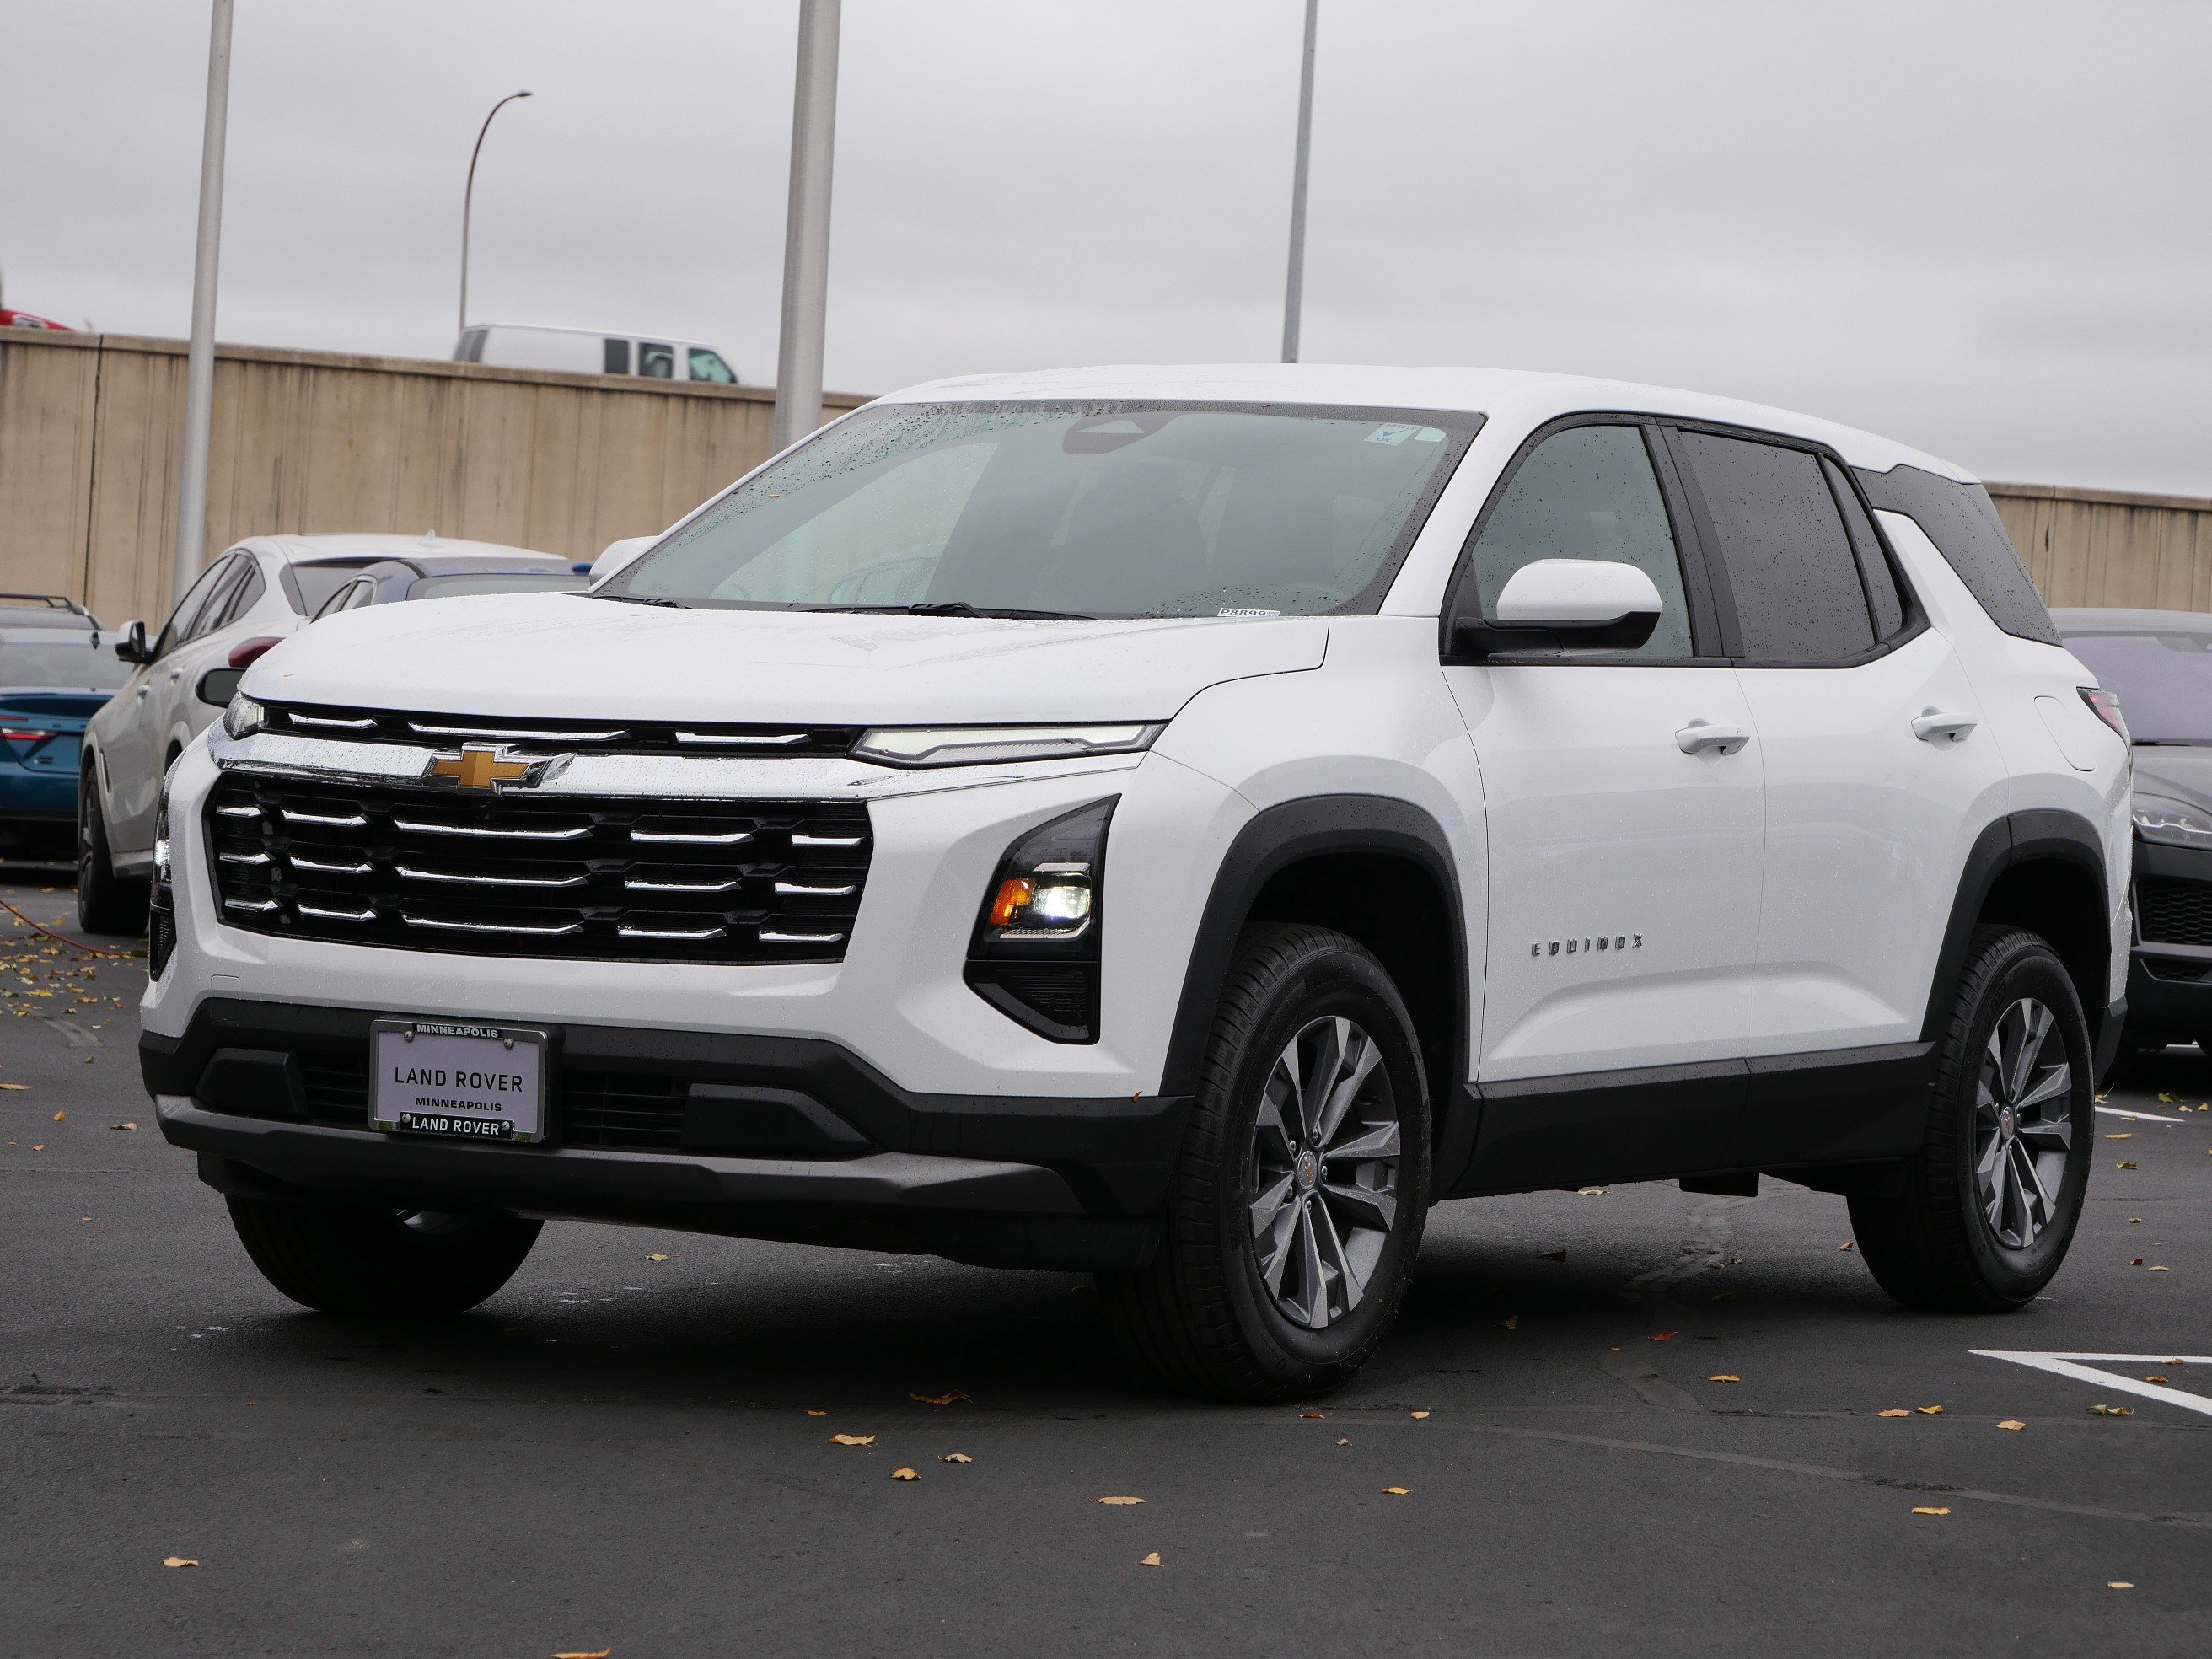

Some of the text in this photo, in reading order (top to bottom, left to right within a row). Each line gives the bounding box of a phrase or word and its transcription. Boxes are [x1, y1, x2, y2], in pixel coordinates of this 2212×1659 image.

[1531, 932, 1644, 957] EQUINOX
[416, 1023, 499, 1039] MINNEAPOLIS
[395, 1066, 523, 1093] LAND ROVER
[415, 1097, 502, 1112] MINNEAPOLIS
[411, 1116, 500, 1136] LAND ROVER
